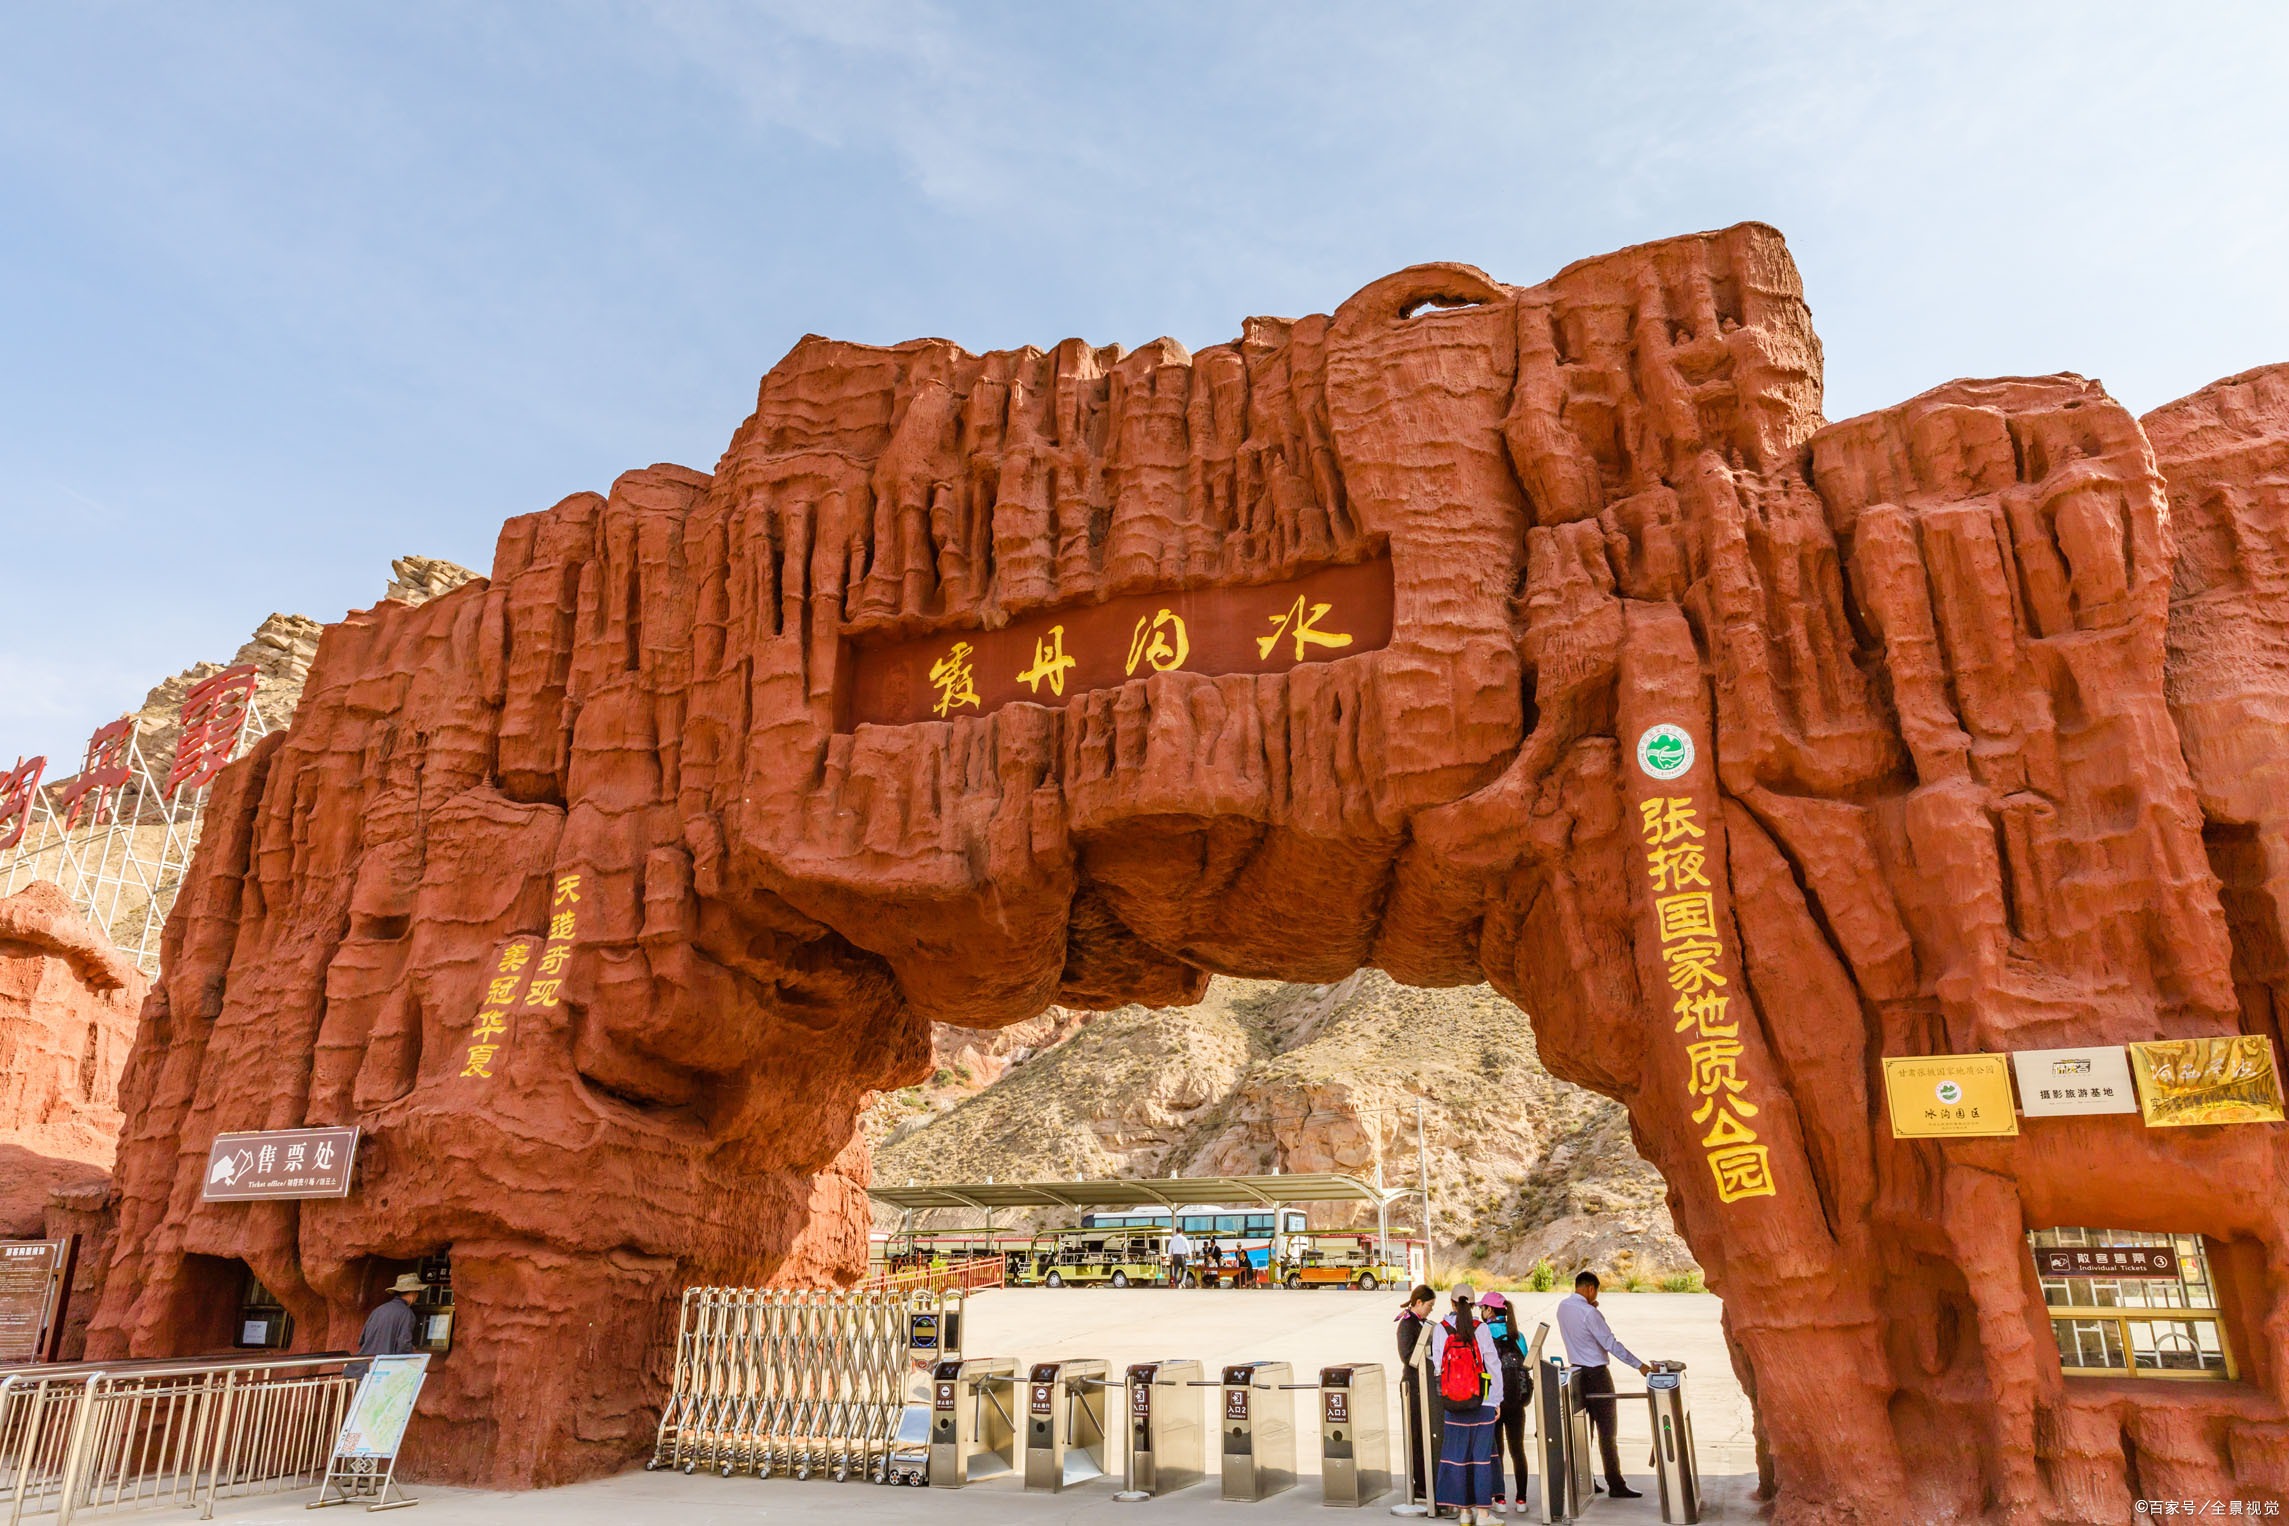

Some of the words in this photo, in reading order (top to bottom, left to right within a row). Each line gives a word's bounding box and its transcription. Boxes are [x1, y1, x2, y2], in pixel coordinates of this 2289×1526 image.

[524, 874, 581, 1007] 天造奇观
[460, 943, 531, 1078] 美冠华夏
[1639, 796, 1776, 1203] 张掖国家地质公园
[257, 1140, 335, 1174] 售票处
[2077, 1252, 2146, 1264] 散客售票
[1228, 1406, 1247, 1414] 入口2
